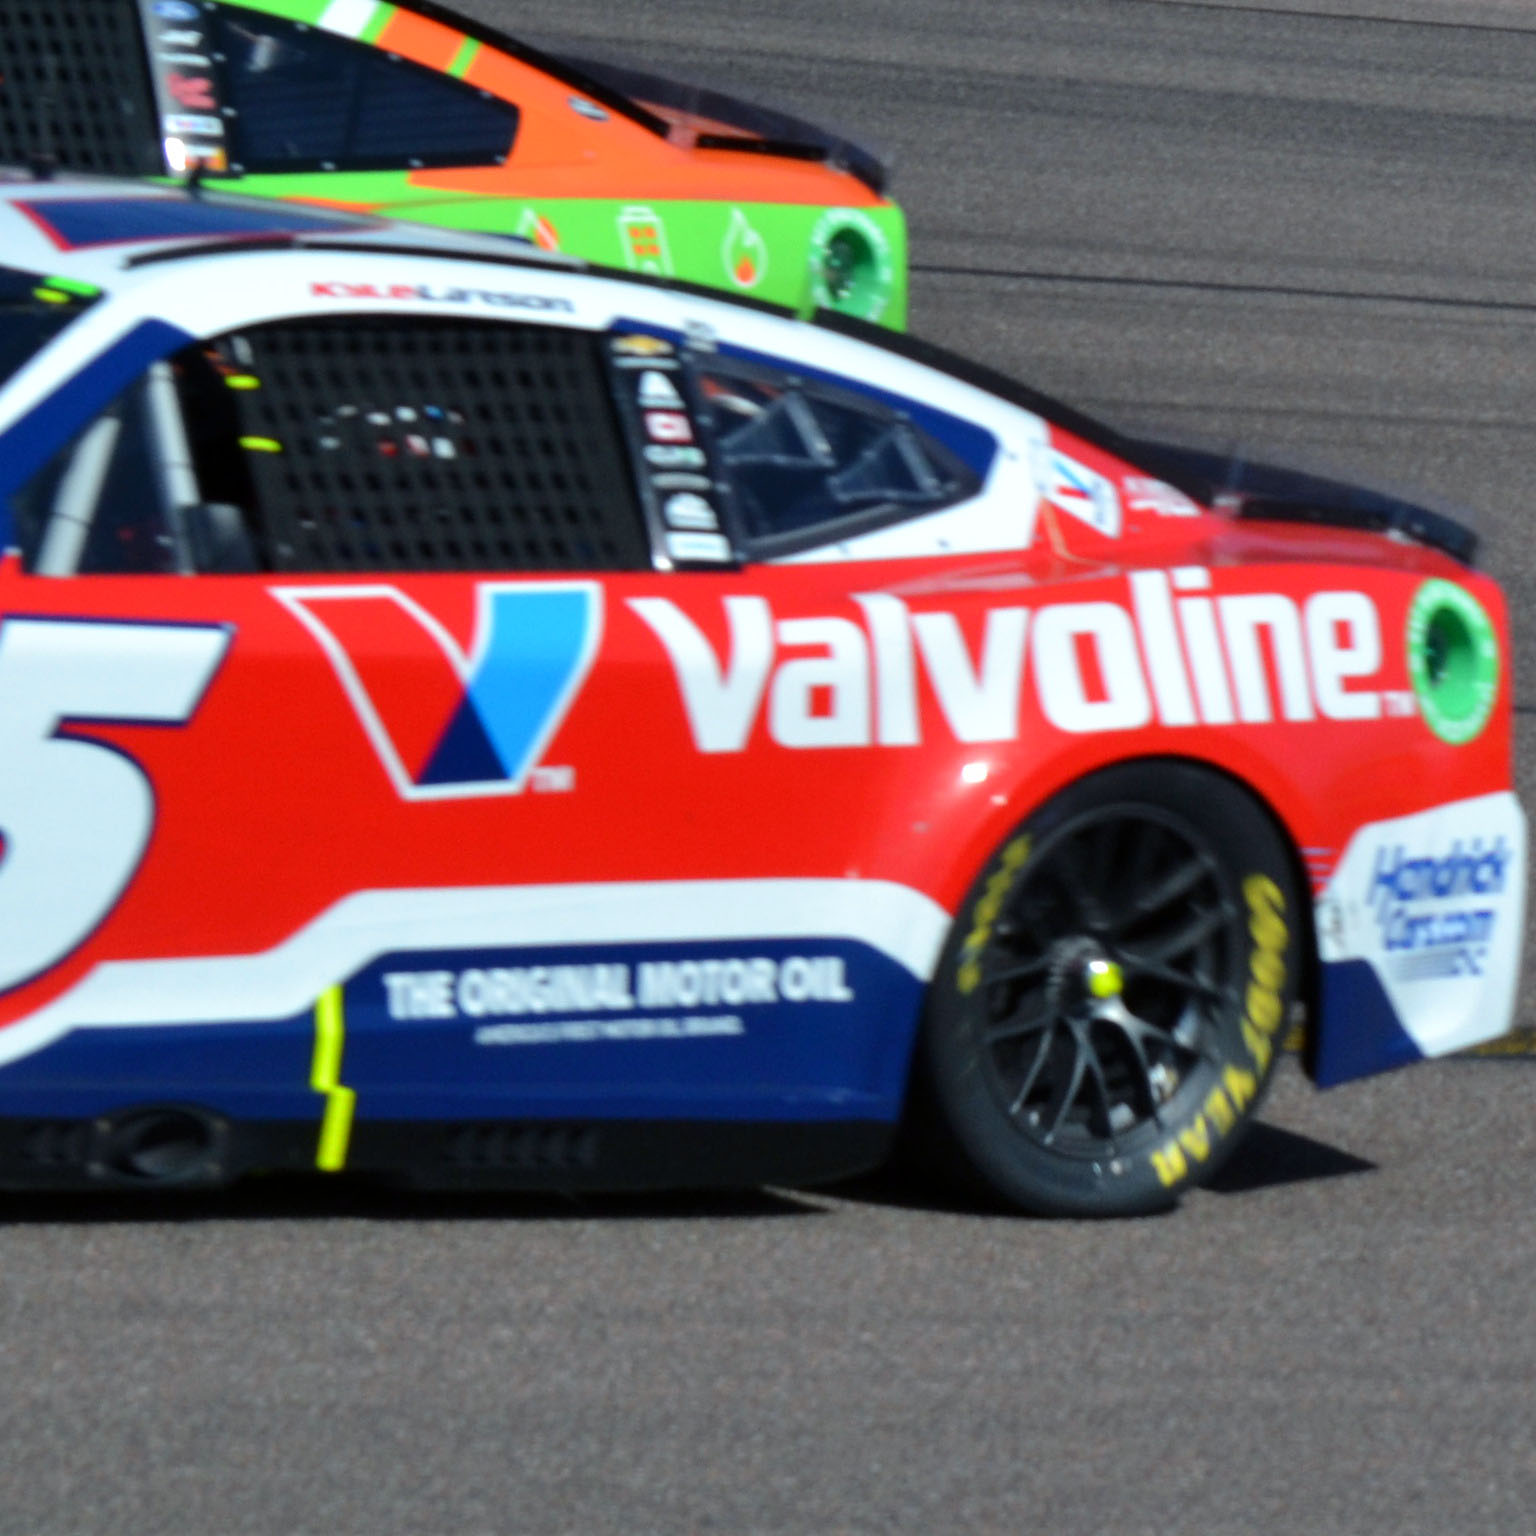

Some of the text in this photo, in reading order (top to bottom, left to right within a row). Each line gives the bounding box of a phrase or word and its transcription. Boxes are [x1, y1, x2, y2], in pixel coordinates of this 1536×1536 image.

[623, 566, 1386, 754] Valvoline
[383, 970, 457, 1020] THE
[457, 962, 637, 1017] ORIGINAL
[636, 957, 780, 1009] MOTOR
